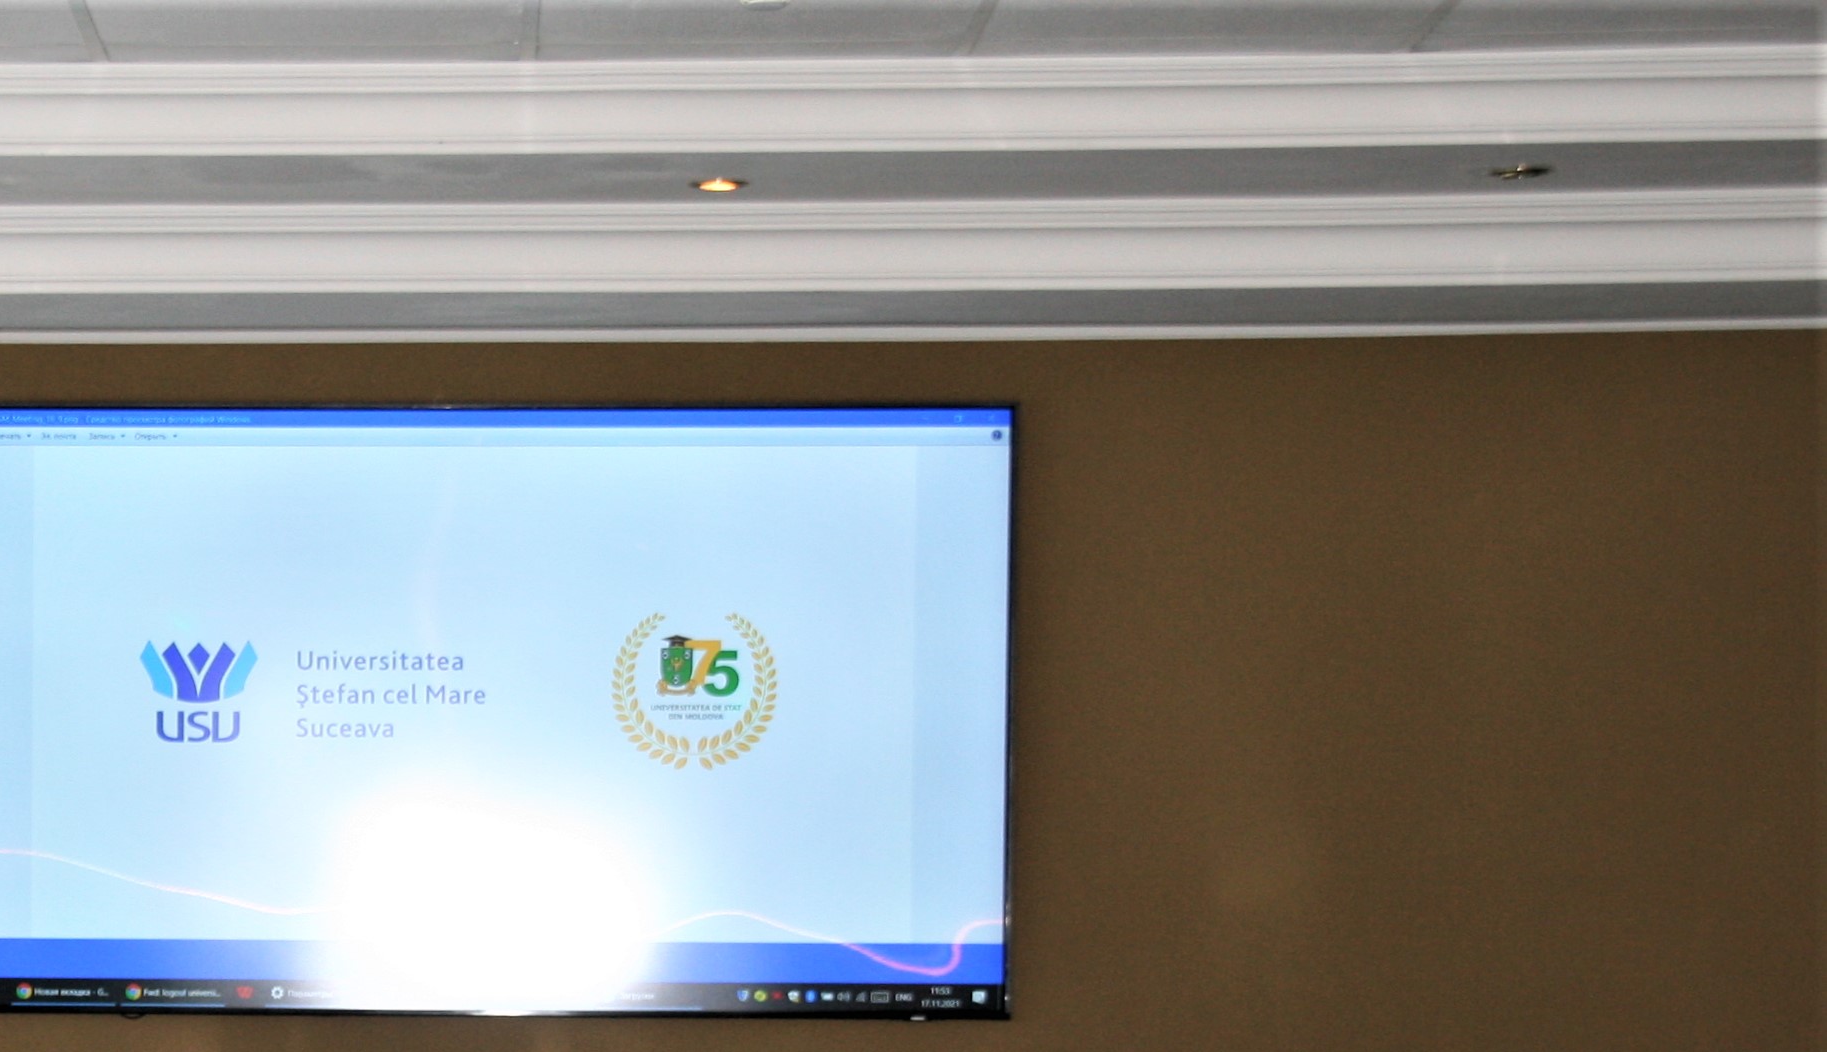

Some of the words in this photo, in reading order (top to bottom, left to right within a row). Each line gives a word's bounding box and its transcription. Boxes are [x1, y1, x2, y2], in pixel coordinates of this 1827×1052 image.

[296, 650, 464, 671] Universitatea
[685, 640, 740, 697] 75
[383, 684, 418, 705] cel
[426, 685, 487, 705] Mare
[296, 718, 395, 738] Suceava
[34, 988, 59, 996] Новая
[895, 993, 913, 1001] ENG
